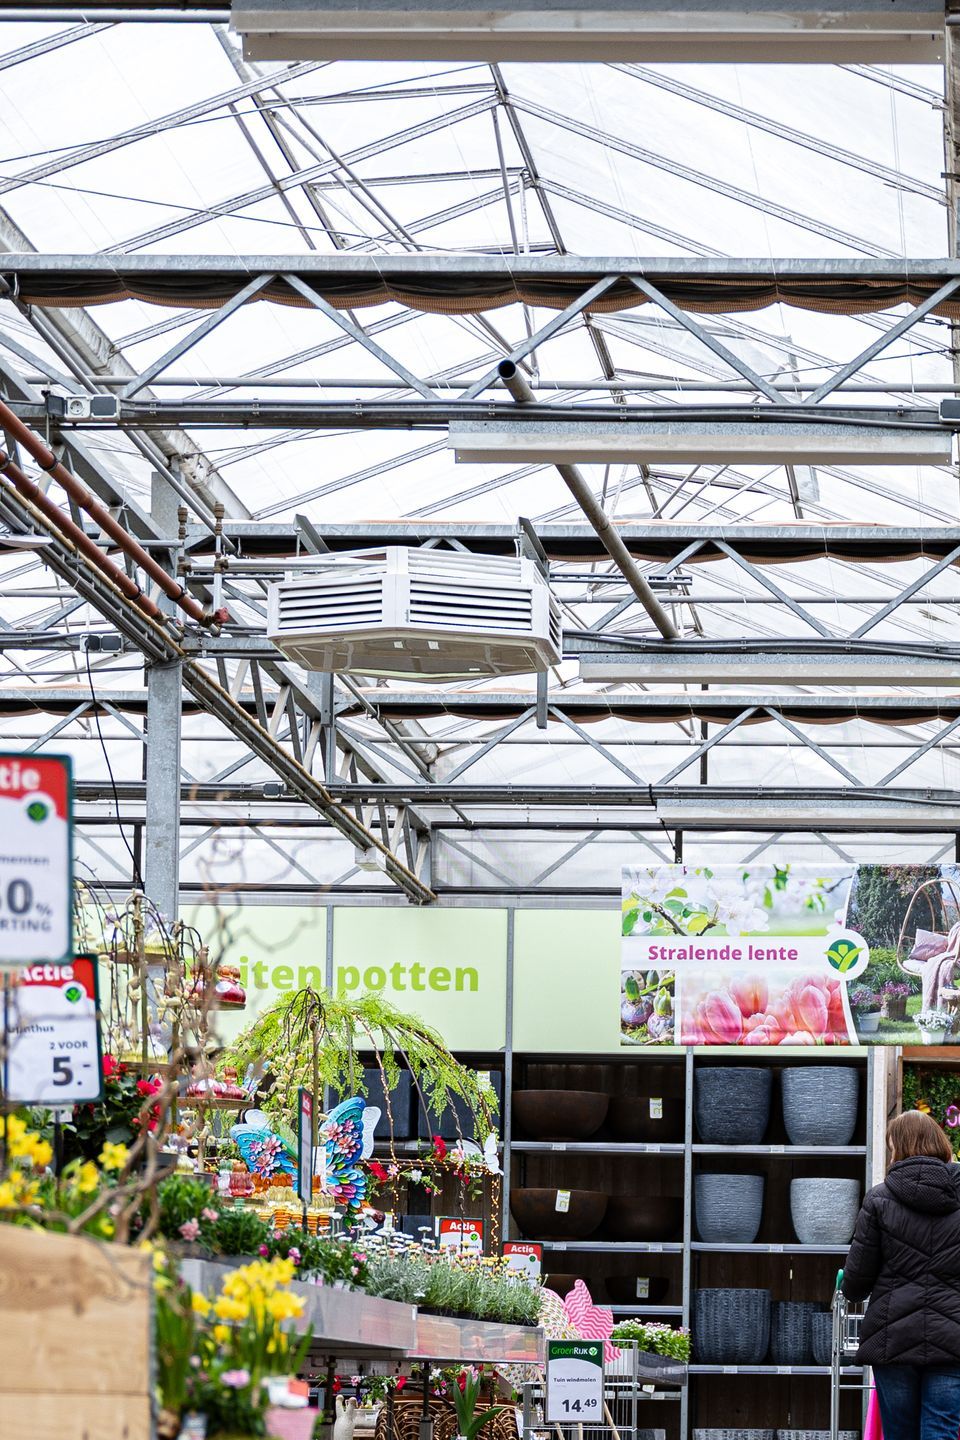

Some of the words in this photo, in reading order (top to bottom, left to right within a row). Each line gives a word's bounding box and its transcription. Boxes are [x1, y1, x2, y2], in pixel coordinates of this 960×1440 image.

[648, 944, 743, 961] Stralende
[748, 944, 798, 961] lente
[18, 964, 75, 982] Actie
[337, 961, 480, 993] potten
[49, 1041, 56, 1050] 2
[58, 1040, 89, 1050] VOOR
[449, 1222, 476, 1231] Actie
[510, 1245, 534, 1253] Actie
[562, 1398, 598, 1413] 14.49
